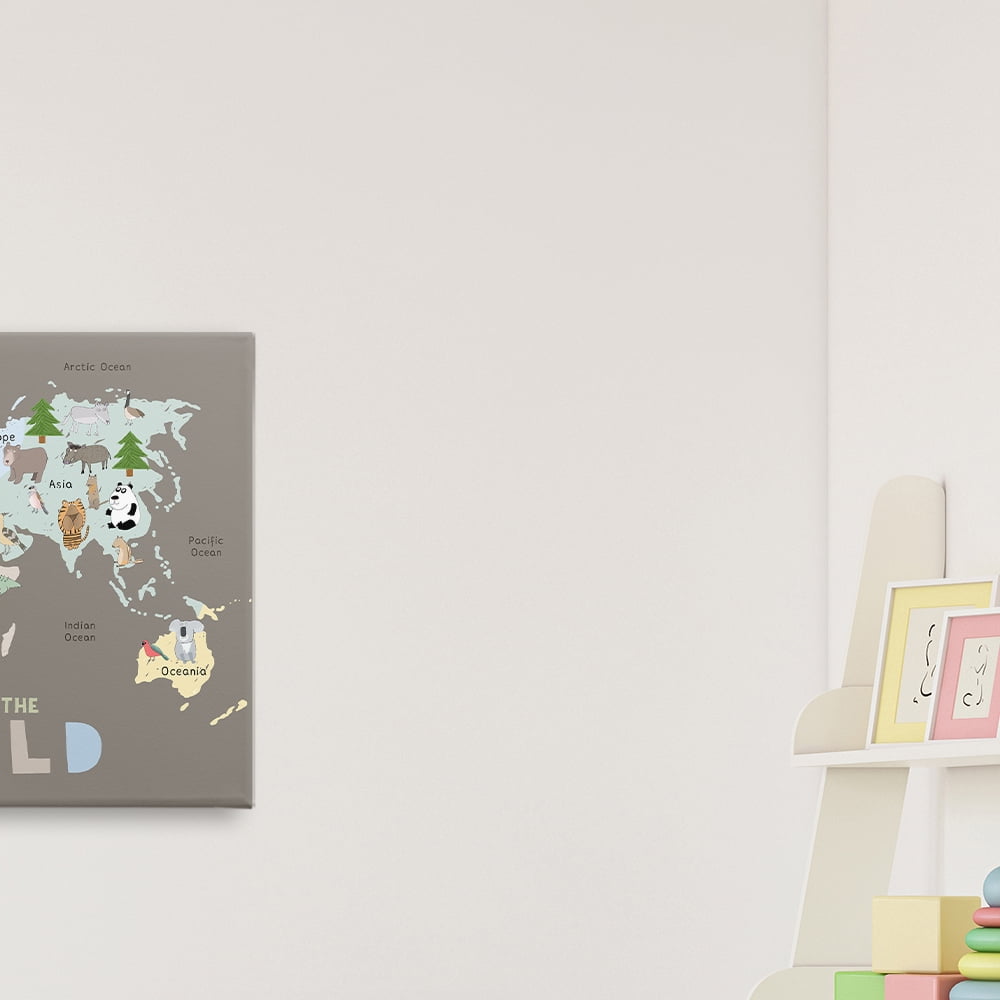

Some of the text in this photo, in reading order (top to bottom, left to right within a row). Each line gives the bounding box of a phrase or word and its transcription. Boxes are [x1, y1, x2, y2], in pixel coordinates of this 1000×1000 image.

[64, 362, 131, 372] Arctic Ocean
[49, 479, 73, 489] Asia
[188, 535, 223, 547] Pacific
[191, 547, 222, 557] Ocean
[64, 621, 96, 630] Indian
[64, 632, 96, 642] Ocean
[161, 666, 207, 676] Oceania
[1, 697, 39, 714] THE
